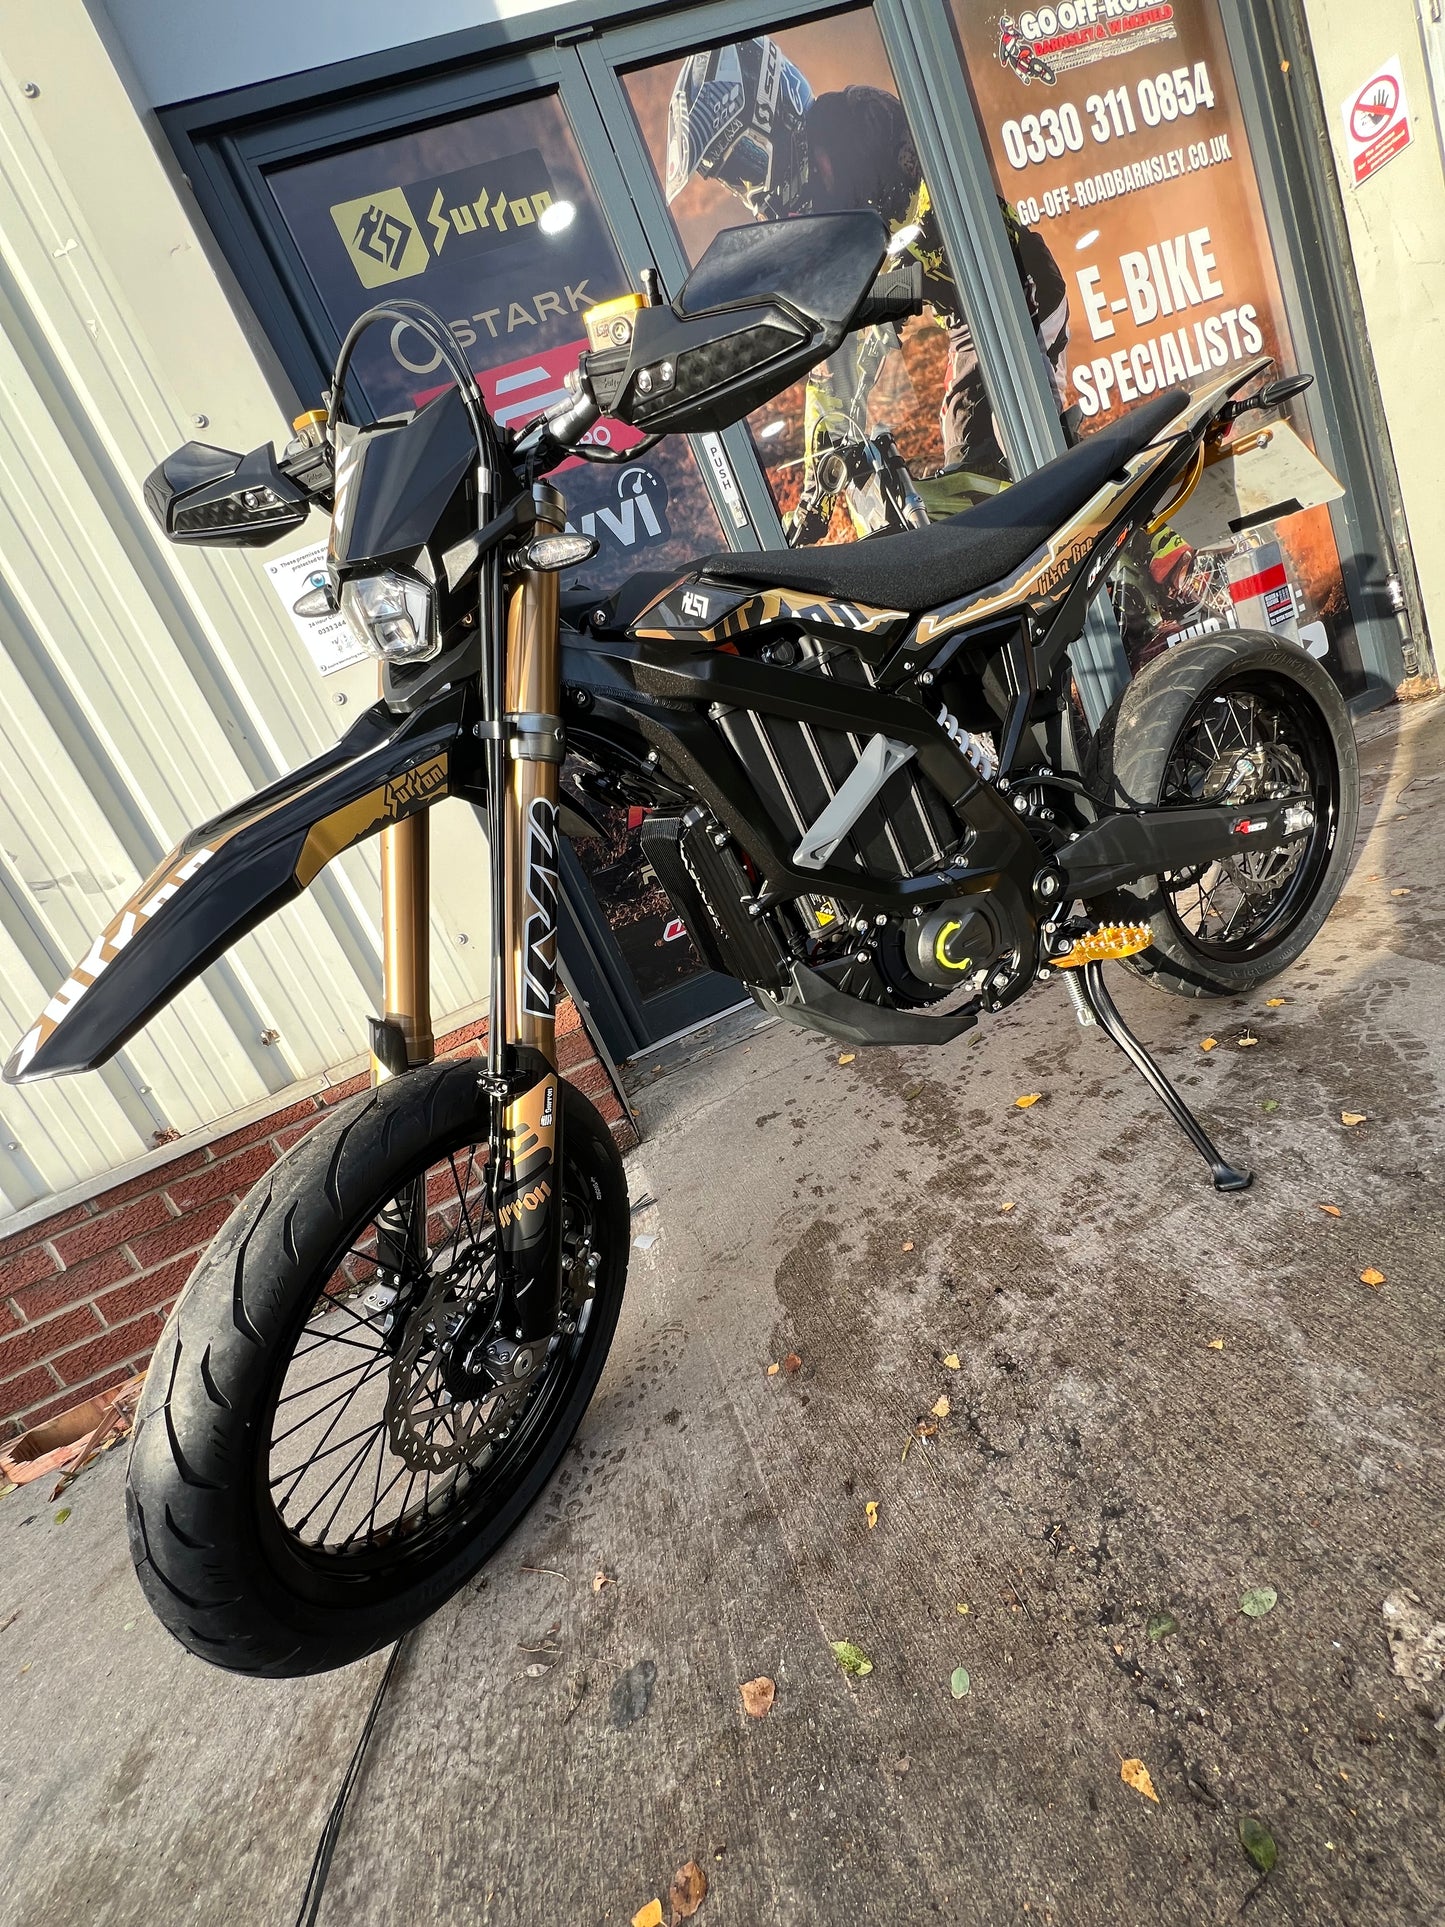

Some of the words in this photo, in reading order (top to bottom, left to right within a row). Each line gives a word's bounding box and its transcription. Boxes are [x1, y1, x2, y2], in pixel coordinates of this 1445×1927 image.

[1020, 7, 1058, 41] GO
[1058, 0, 1168, 30] OFF-R
[1032, 27, 1095, 57] BARNSLEY
[1096, 25, 1107, 39] &
[1107, 5, 1173, 36] WAKEFIELD
[1001, 102, 1084, 171] 0330
[1085, 86, 1137, 144] 311
[1136, 61, 1215, 128] 0854
[1016, 134, 1233, 227] GO-OFF-ROADBARNSLEY.CO.UK
[448, 279, 600, 351] STARK
[1075, 226, 1224, 342] E-BIKE
[1071, 303, 1264, 417] SPECIALISTS
[710, 446, 732, 491] PUSH
[384, 763, 446, 819] Surron
